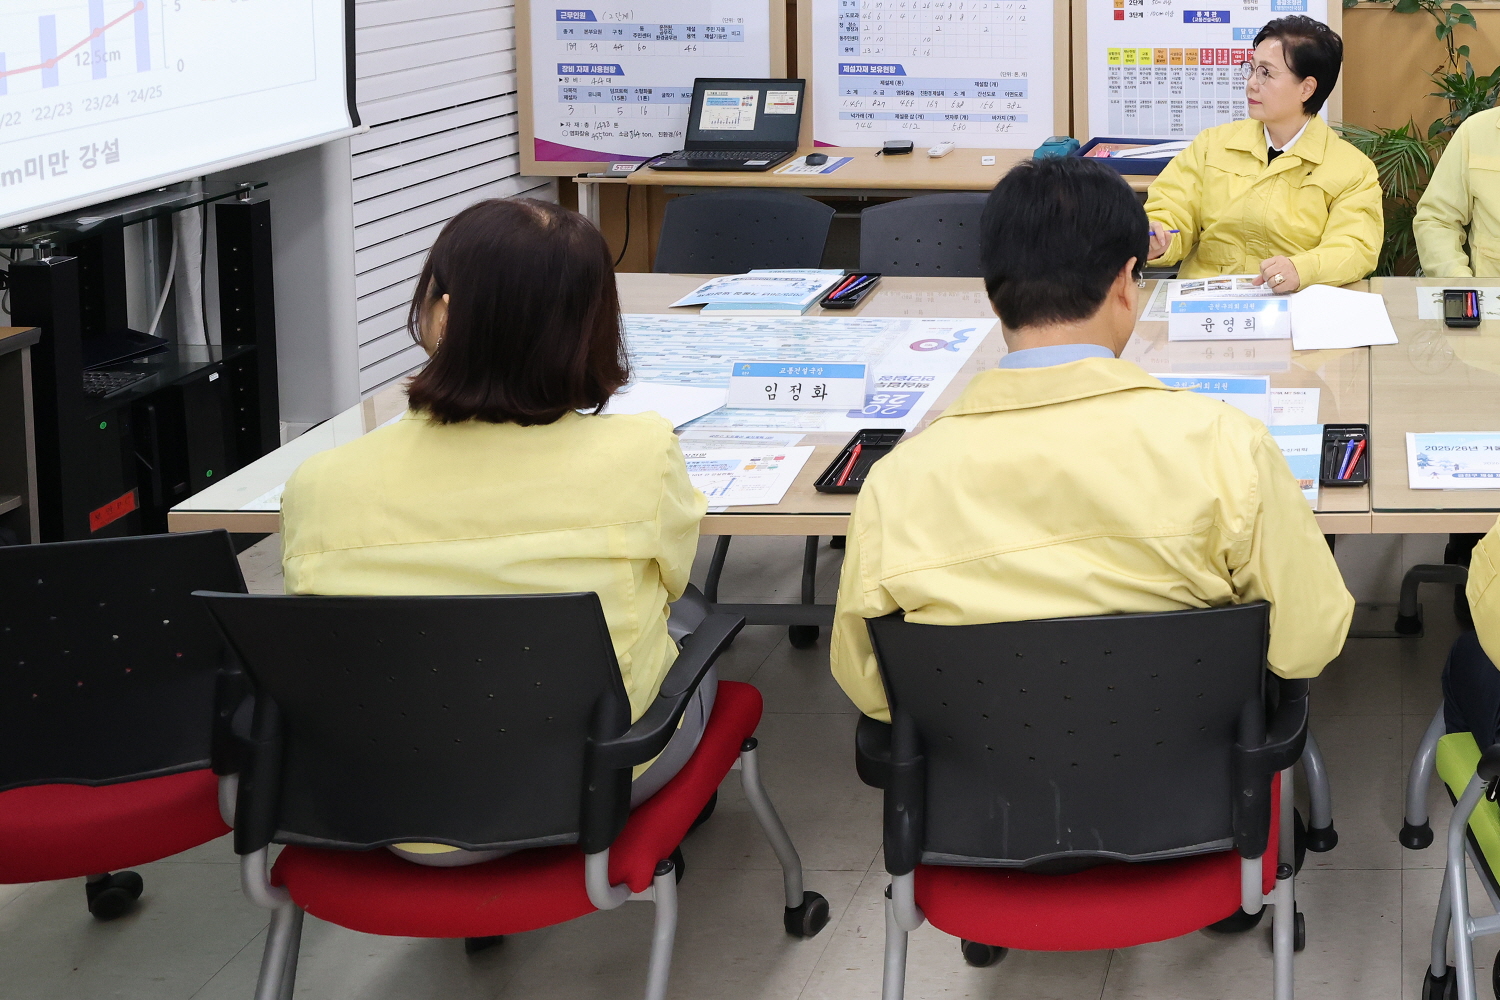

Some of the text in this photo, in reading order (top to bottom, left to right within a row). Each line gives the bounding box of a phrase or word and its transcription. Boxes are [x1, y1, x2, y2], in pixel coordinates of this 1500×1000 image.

[560, 12, 586, 20] 근무인원
[74, 49, 121, 66] 12.5cm
[177, 59, 184, 72] 0
[79, 138, 120, 170] 강설
[870, 394, 910, 404] 25
[862, 404, 902, 414] 20
